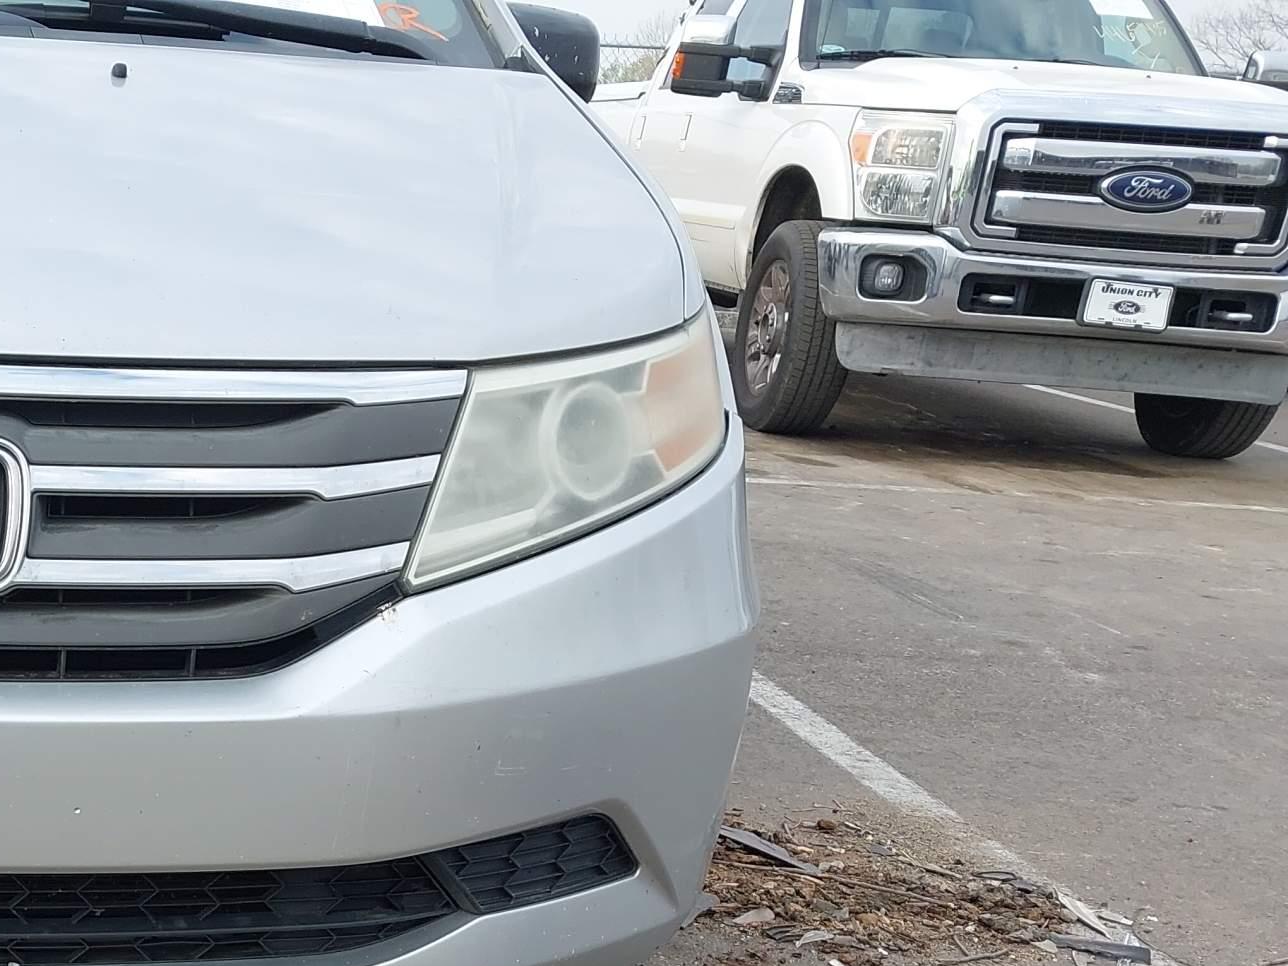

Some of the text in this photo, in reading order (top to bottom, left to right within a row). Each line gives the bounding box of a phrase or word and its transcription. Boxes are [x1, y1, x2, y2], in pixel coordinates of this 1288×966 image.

[1123, 176, 1175, 200] Ford
[1101, 283, 1162, 299] UNION CITY
[1117, 302, 1136, 313] Ford
